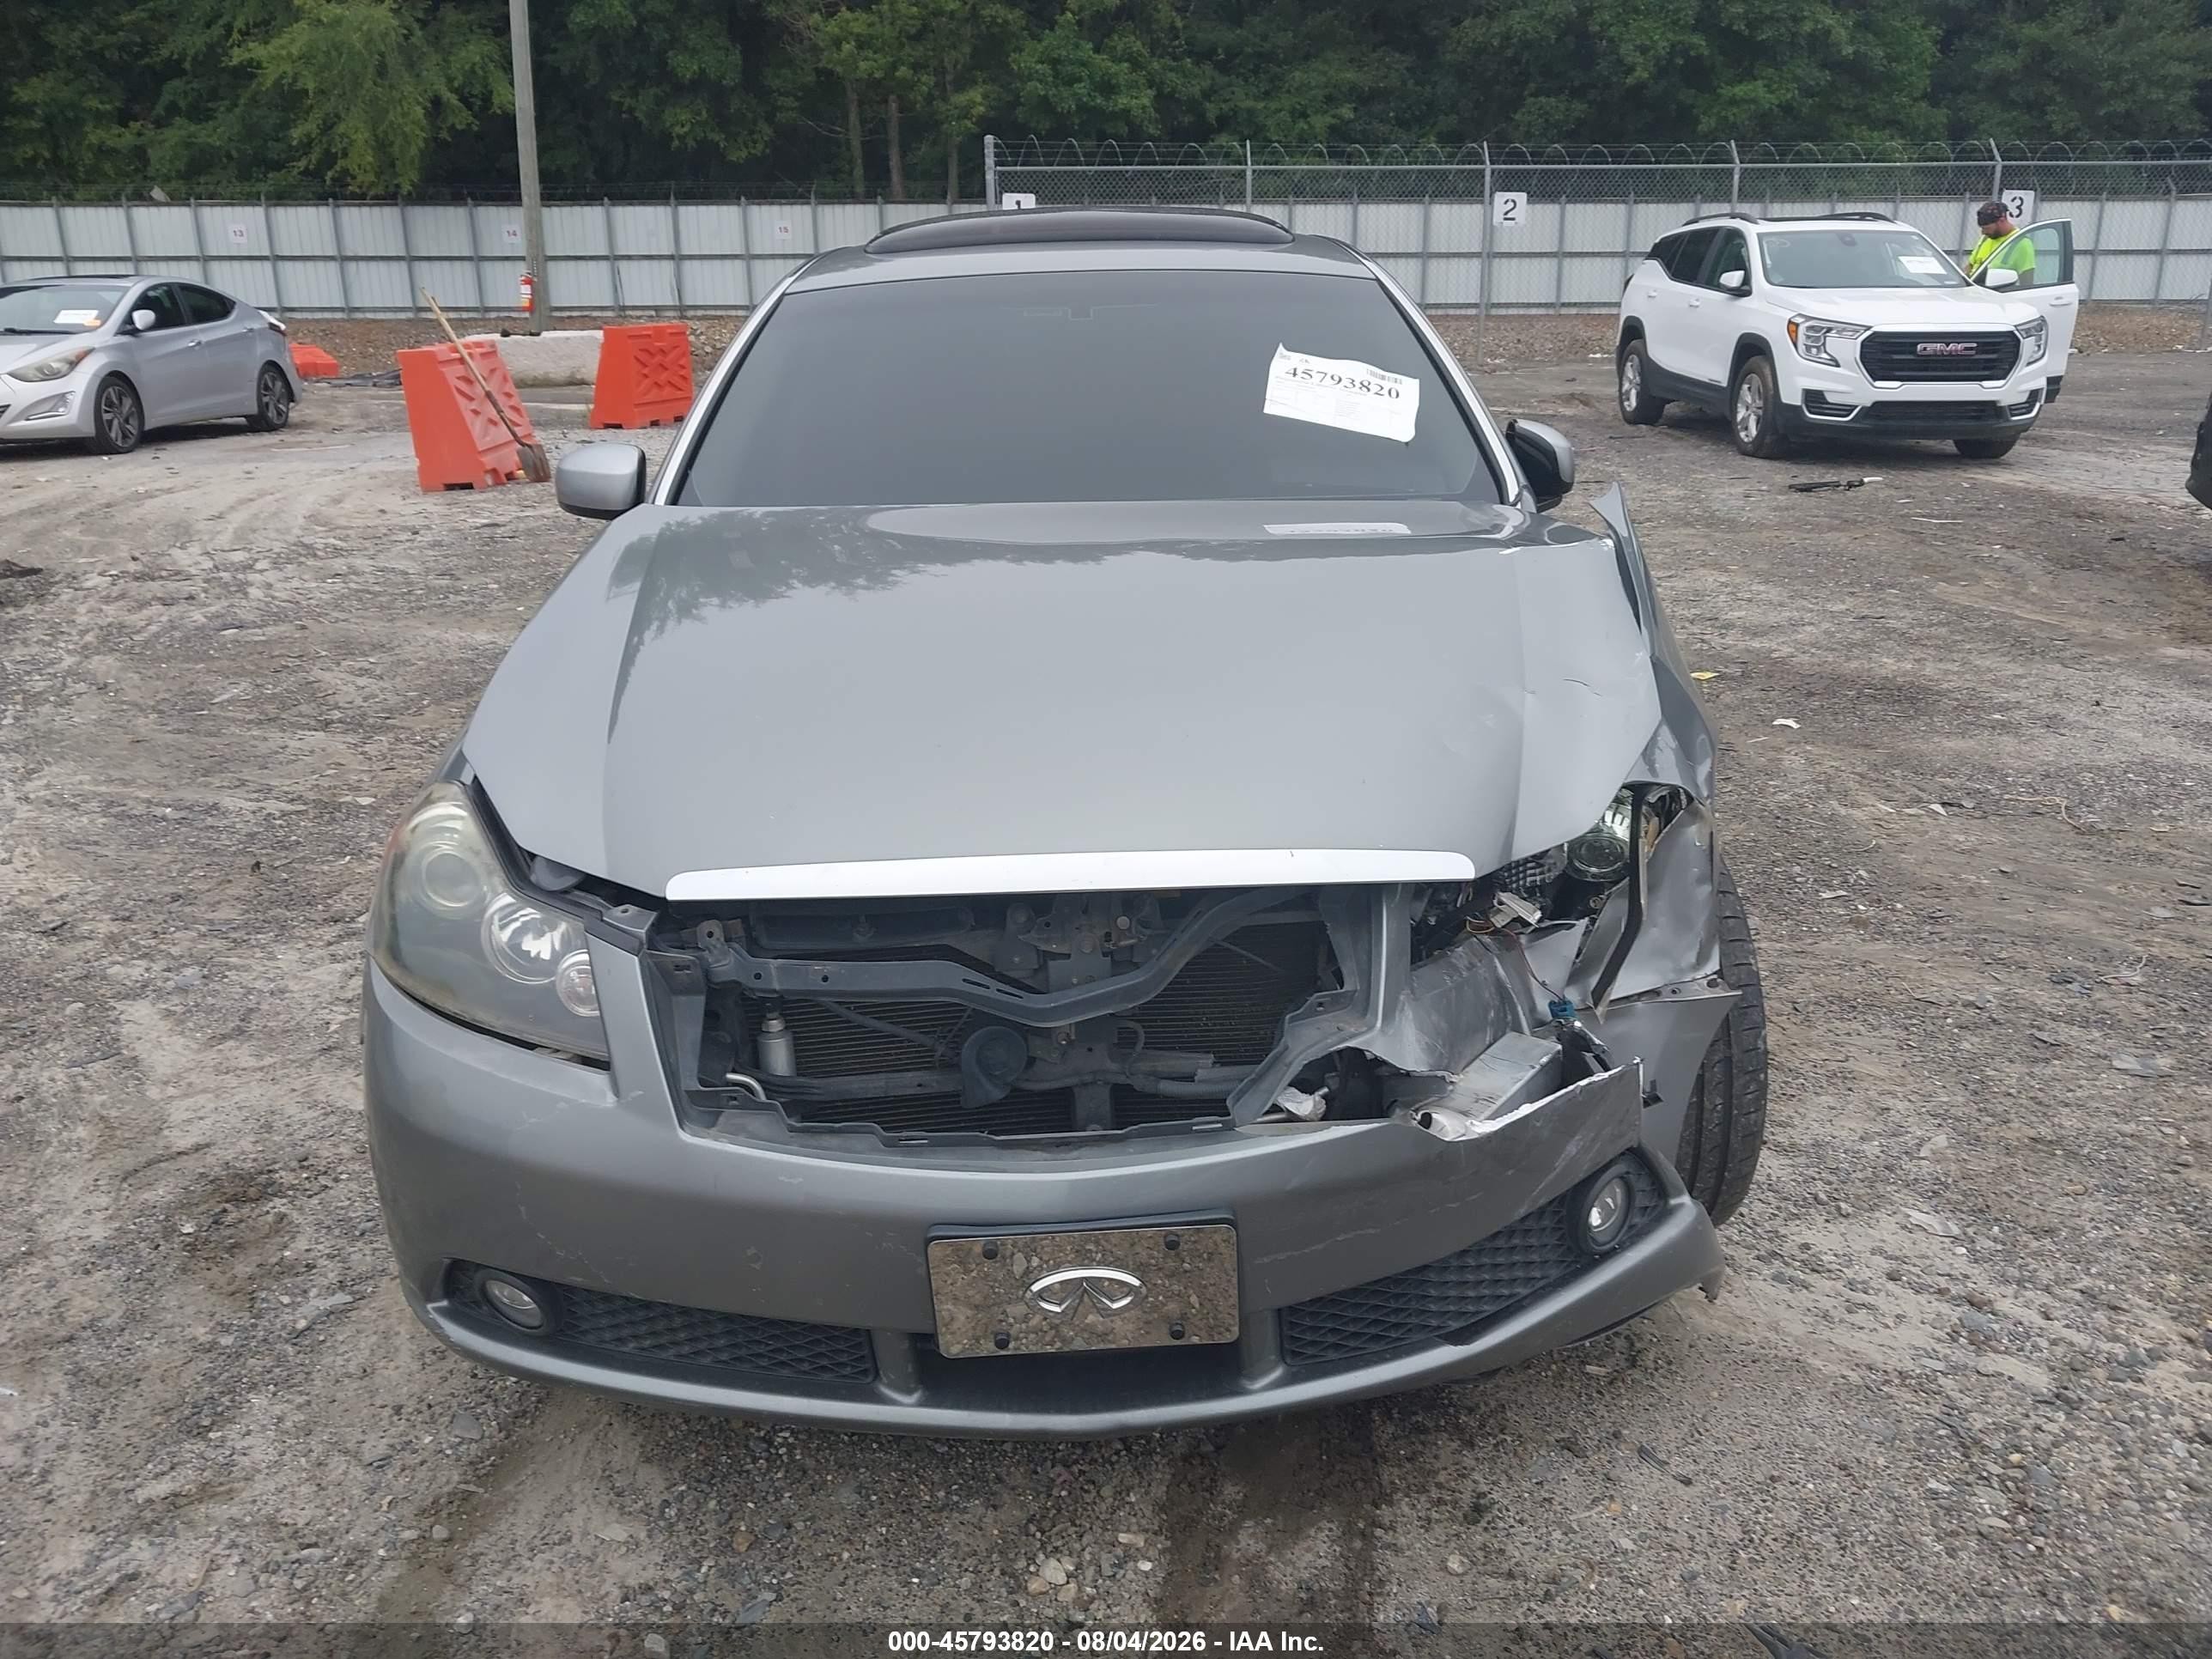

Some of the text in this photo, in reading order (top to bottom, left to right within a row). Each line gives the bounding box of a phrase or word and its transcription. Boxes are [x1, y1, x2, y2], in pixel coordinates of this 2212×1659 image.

[1503, 198, 1516, 221] 2
[2009, 196, 2024, 218] 3
[1916, 343, 1978, 356] GMC
[1284, 367, 1401, 400] 45793820
